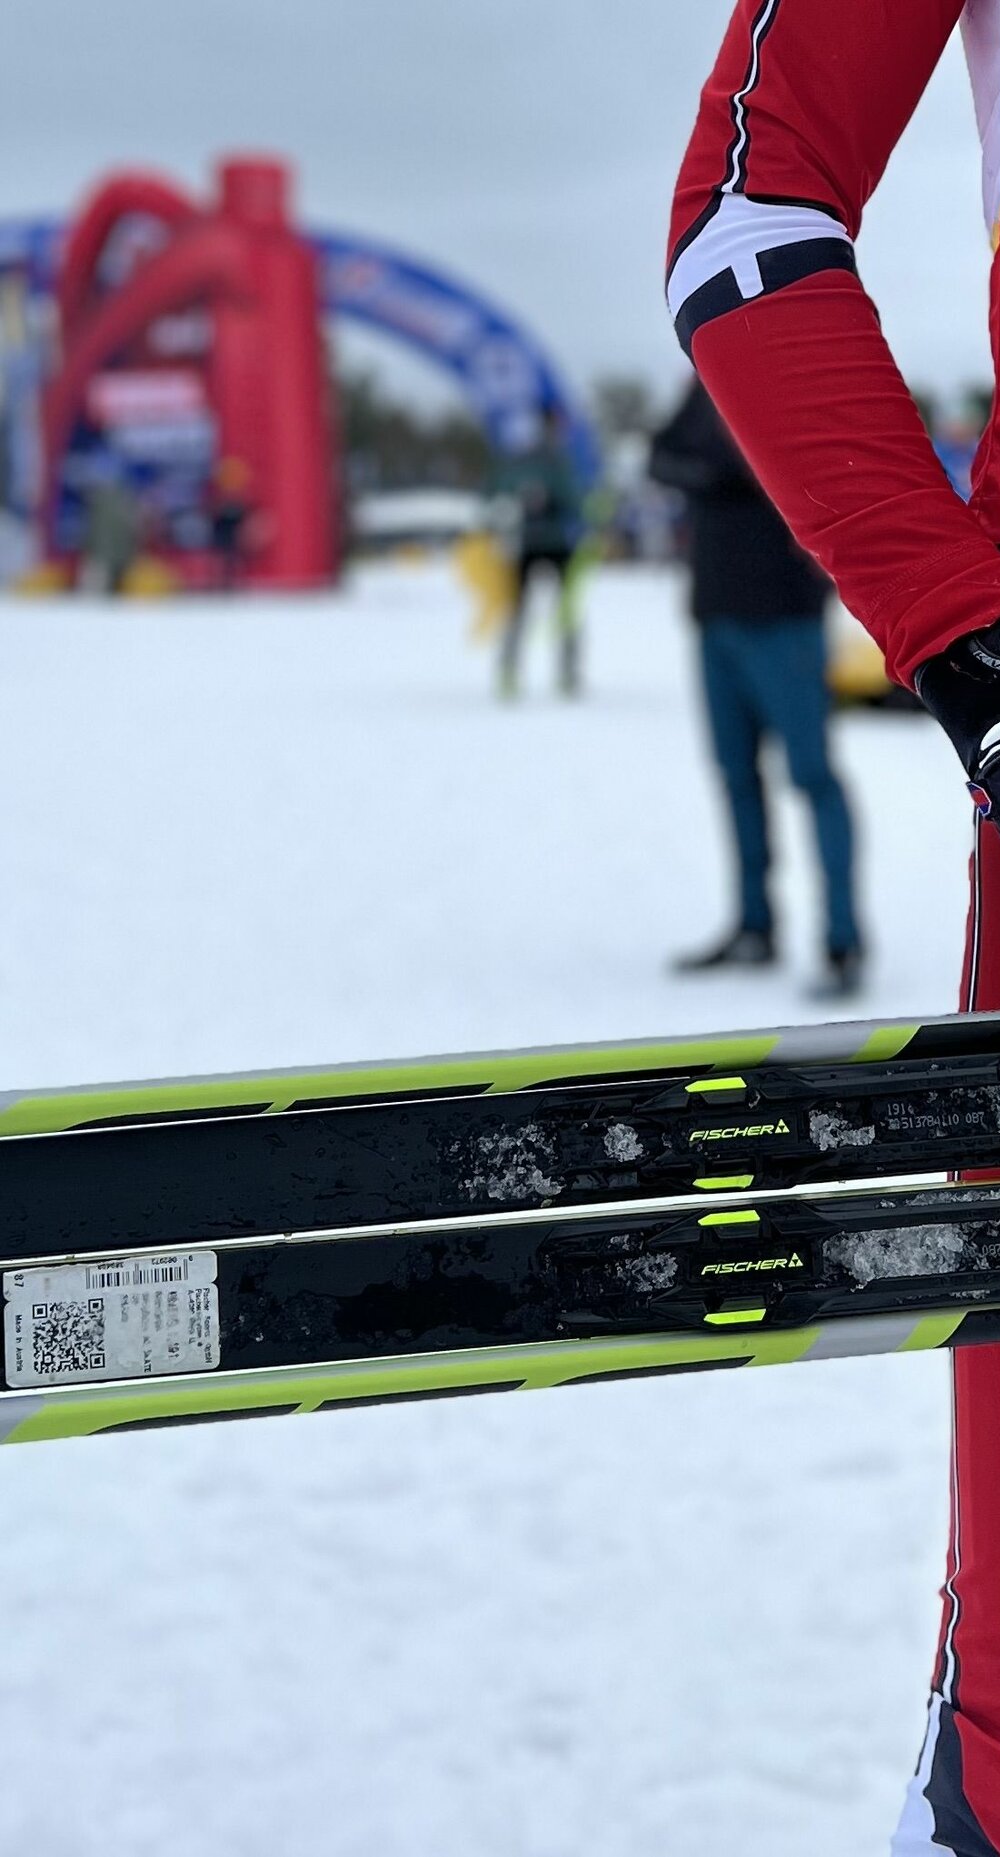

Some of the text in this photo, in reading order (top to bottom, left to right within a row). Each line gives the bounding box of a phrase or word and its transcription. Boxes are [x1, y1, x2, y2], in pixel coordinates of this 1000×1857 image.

[689, 1125, 774, 1141] FISCHER
[701, 1258, 788, 1275] FISCHER
[14, 1273, 24, 1288] 87
